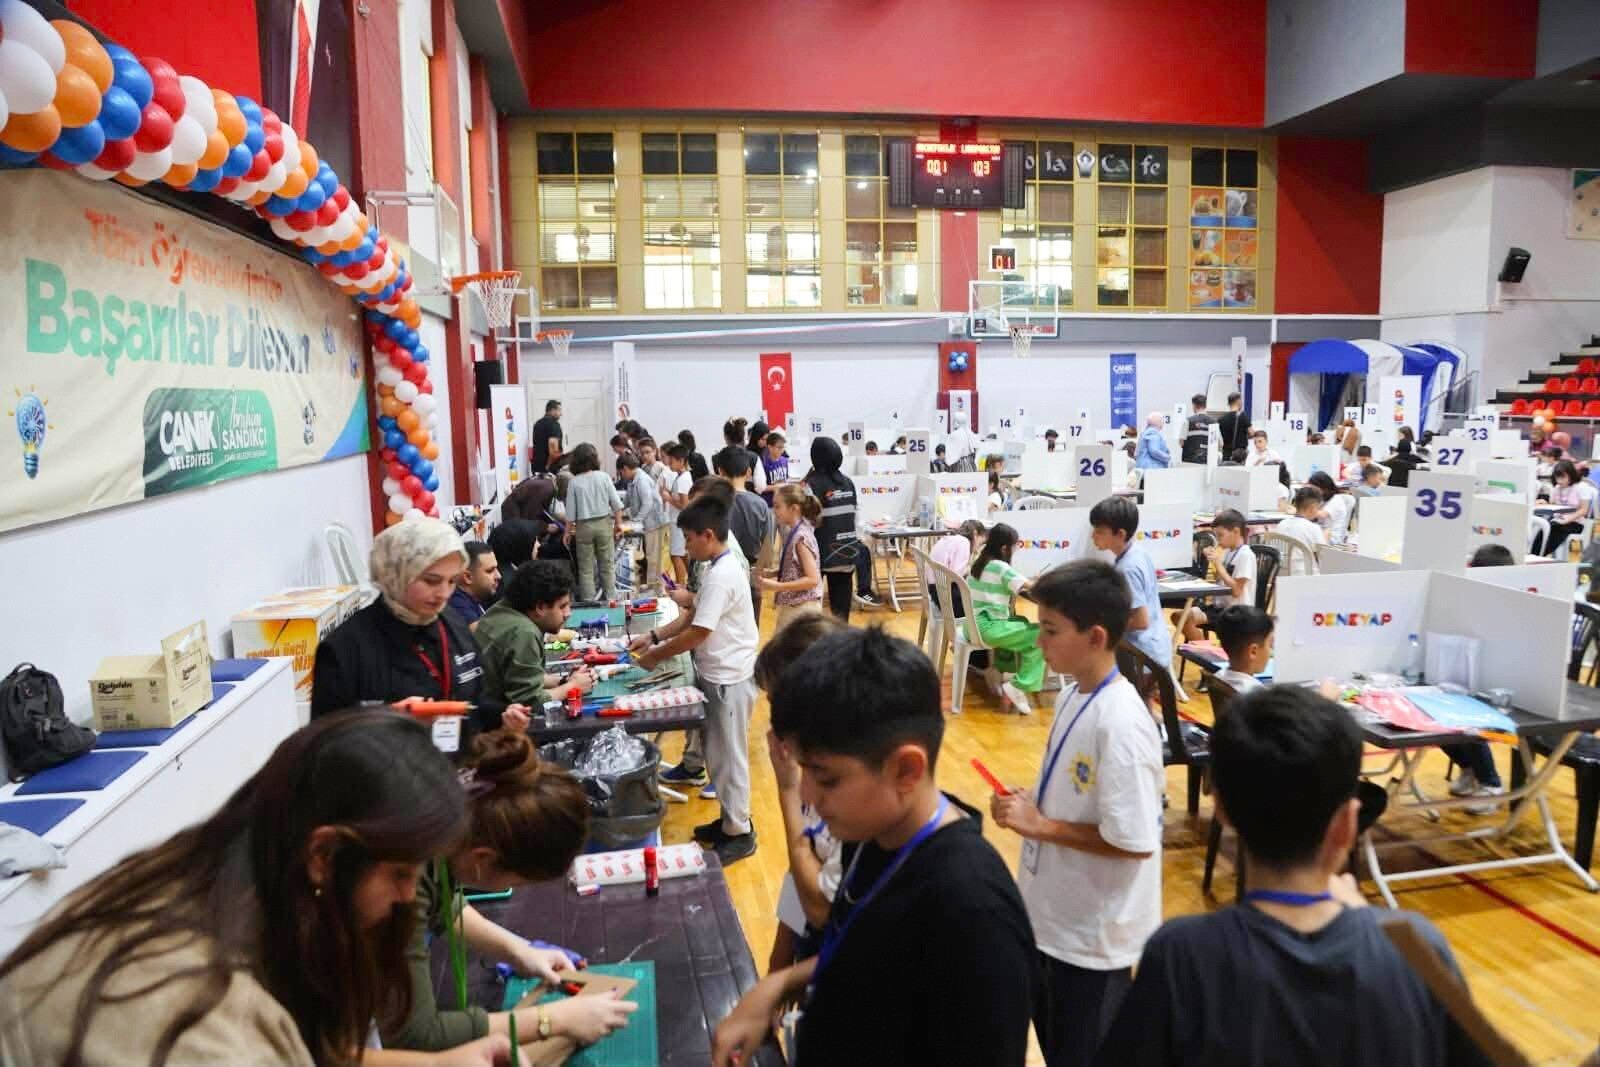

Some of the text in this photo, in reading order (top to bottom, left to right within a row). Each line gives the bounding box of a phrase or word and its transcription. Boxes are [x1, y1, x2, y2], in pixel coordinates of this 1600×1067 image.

[25, 256, 220, 377] Başarılar
[812, 423, 822, 433] 15
[1000, 418, 1011, 428] 14
[1290, 420, 1303, 430] 18
[850, 429, 862, 440] 16
[1070, 425, 1082, 437] 17
[1468, 428, 1488, 440] 23
[505, 407, 518, 481] ENEYAP
[909, 439, 926, 452] 25
[1437, 448, 1464, 466] 27
[1080, 458, 1106, 477] 26
[1415, 488, 1462, 520] 35
[1136, 528, 1181, 541] ENEYAP
[1472, 525, 1503, 536] NEYAP
[1016, 540, 1070, 550] DENEYAP
[1312, 612, 1392, 627] DENEYAP
